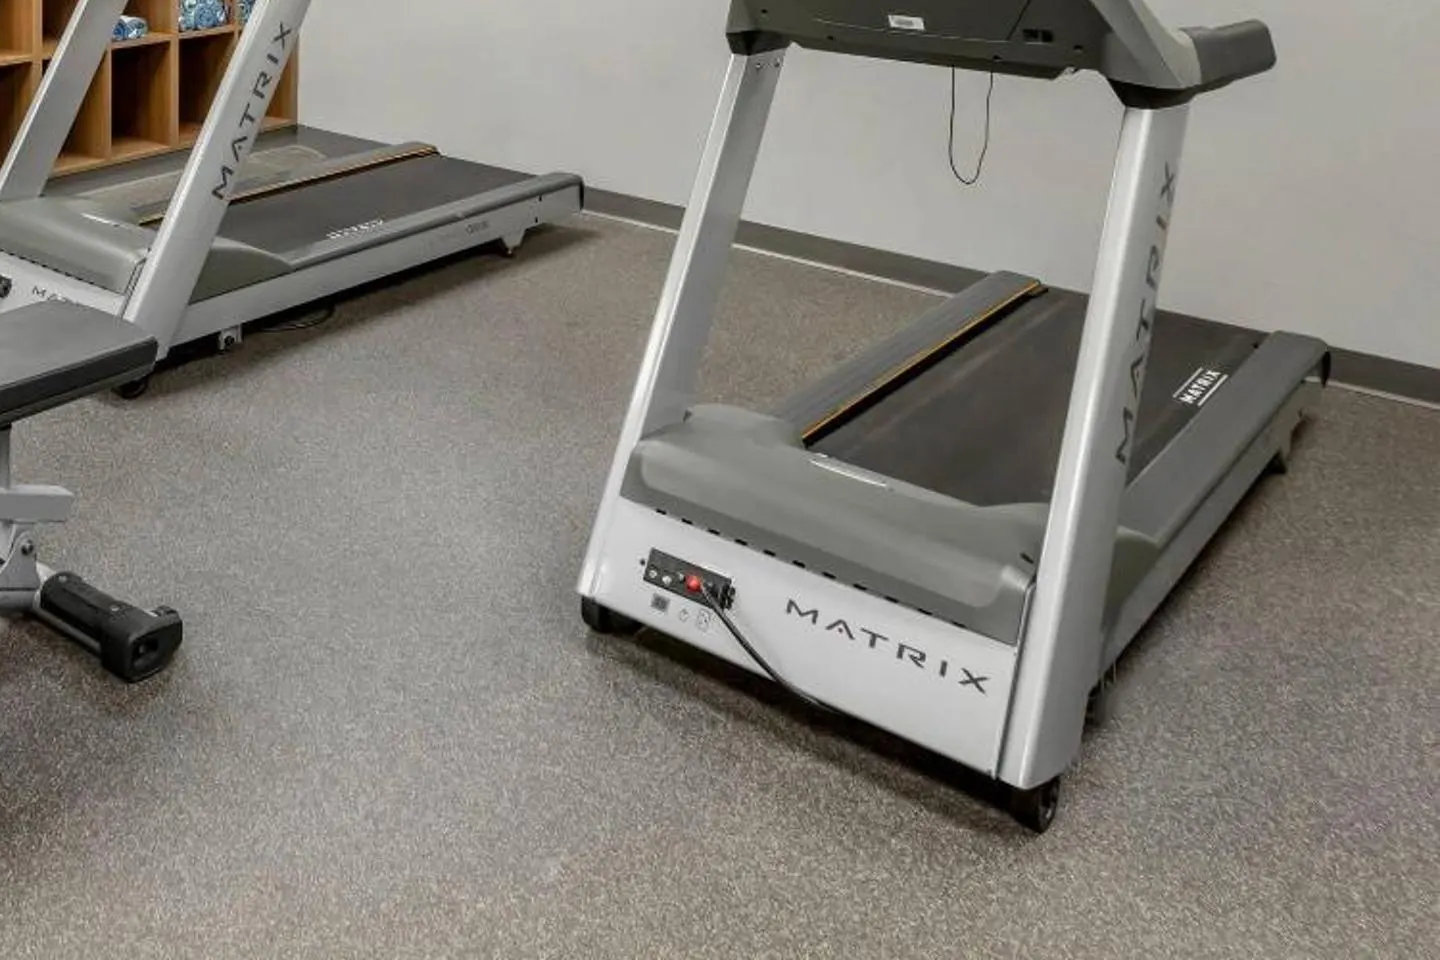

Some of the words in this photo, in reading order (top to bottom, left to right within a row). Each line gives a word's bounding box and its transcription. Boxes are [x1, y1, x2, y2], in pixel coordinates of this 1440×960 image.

[212, 21, 292, 201] MATRIX
[1115, 161, 1175, 464] MATRIX
[1179, 370, 1222, 405] MATRIX
[785, 598, 991, 695] MATRIX
